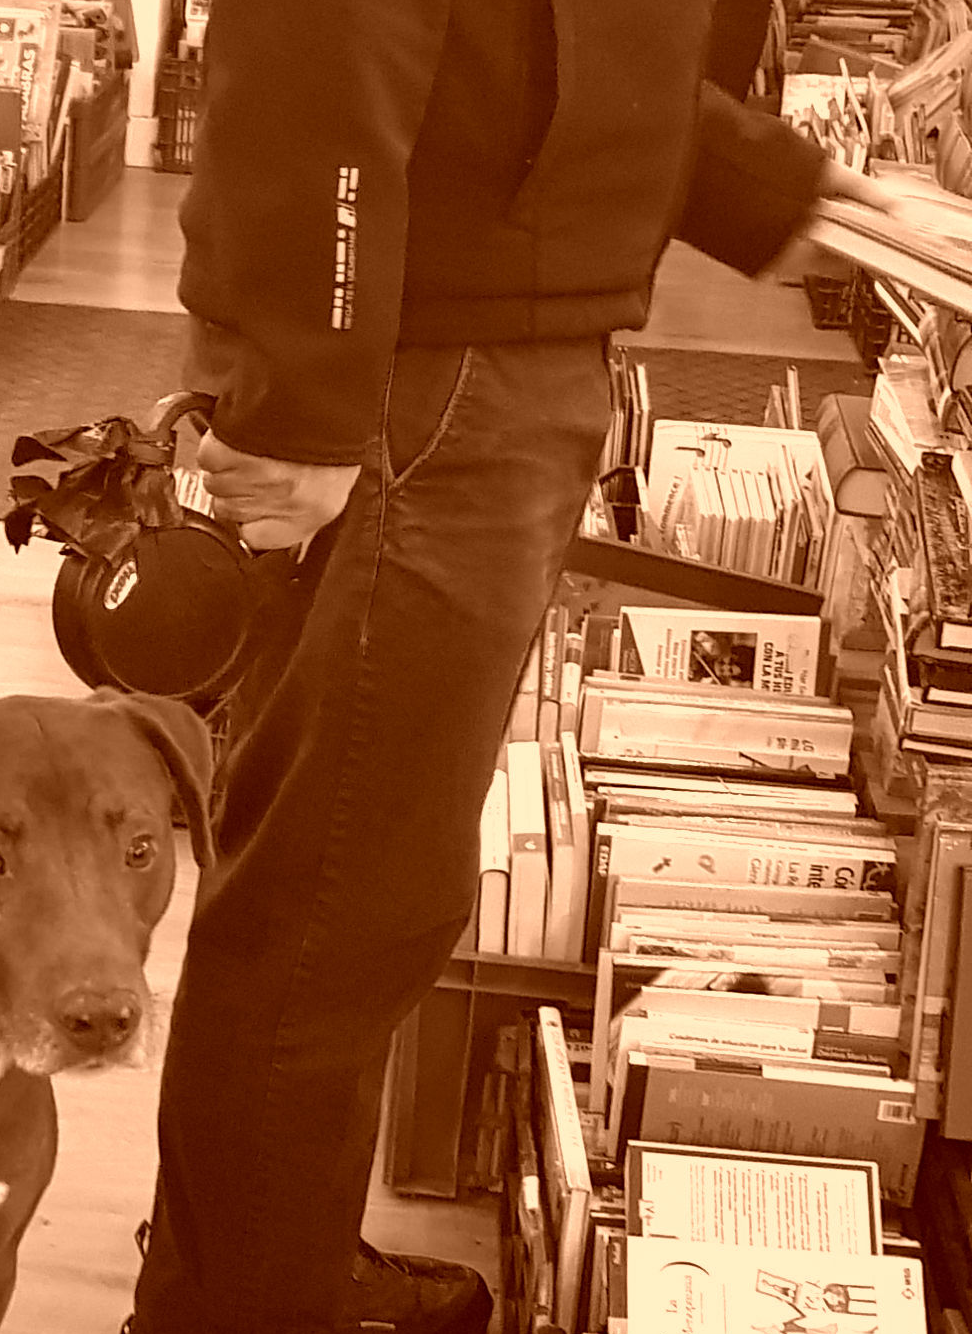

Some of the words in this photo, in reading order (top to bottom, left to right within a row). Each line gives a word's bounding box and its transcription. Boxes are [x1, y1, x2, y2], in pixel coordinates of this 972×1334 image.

[762, 641, 774, 662] CON
[760, 664, 772, 677] LA
[668, 1032, 708, 1042] Cuadernos
[760, 1043, 776, 1051] para
